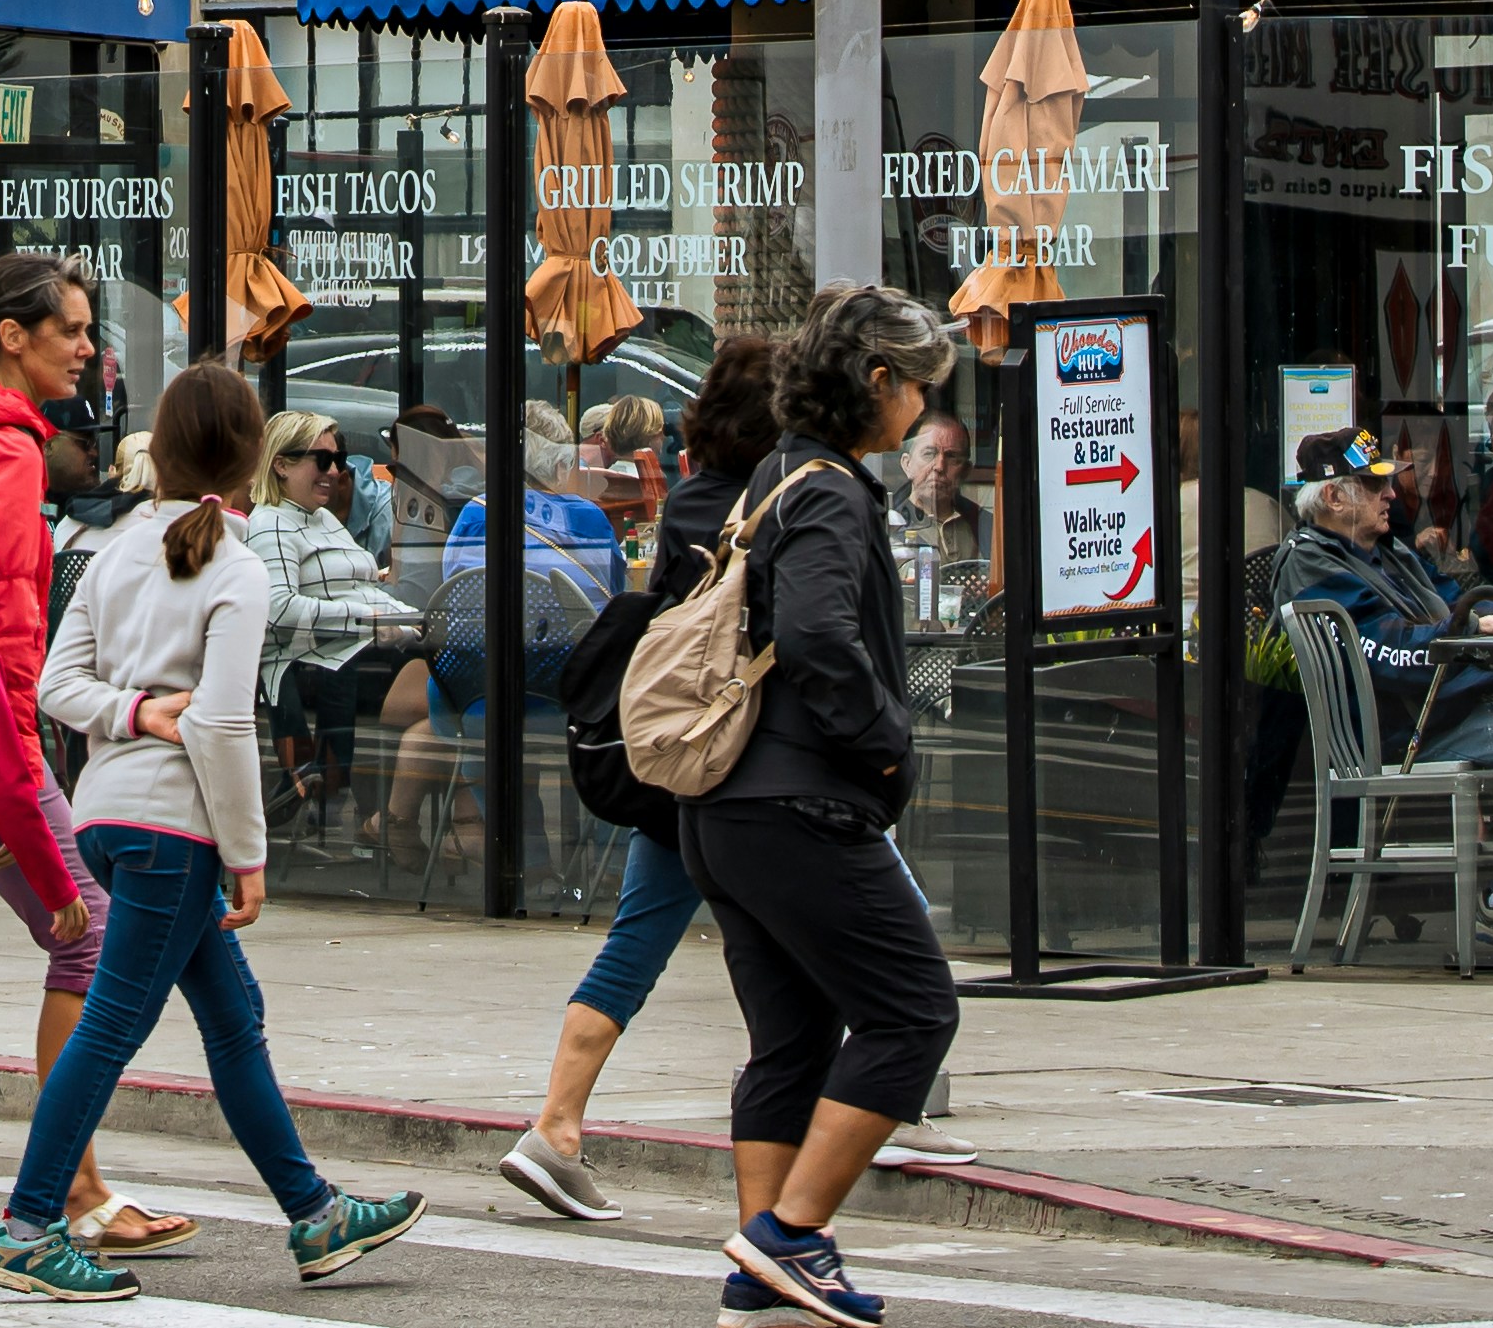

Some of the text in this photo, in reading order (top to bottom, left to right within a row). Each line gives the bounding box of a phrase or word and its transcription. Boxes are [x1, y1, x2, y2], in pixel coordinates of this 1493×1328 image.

[1, 88, 28, 143] EXIT
[539, 161, 805, 210] GRILLED SHRIMP
[881, 143, 1170, 199] FRIED CALAMARI
[54, 176, 175, 220] BURGERS
[275, 169, 437, 217] FISH TACOS
[78, 244, 125, 281] BAR
[295, 241, 416, 282] FULL BAR
[590, 236, 668, 277] COLD
[675, 235, 749, 276] BEER
[950, 224, 1028, 269] FULL
[1035, 224, 1097, 268] BAR
[1059, 328, 1118, 366] Chowder
[1076, 353, 1104, 372] HUT
[1076, 372, 1107, 380] GRILL
[1050, 412, 1135, 441] Restaurant
[1073, 440, 1115, 464] & Bar
[1063, 508, 1126, 535] Walk-up
[1068, 533, 1122, 561] Service
[1059, 561, 1130, 579] Right Around the Corner
